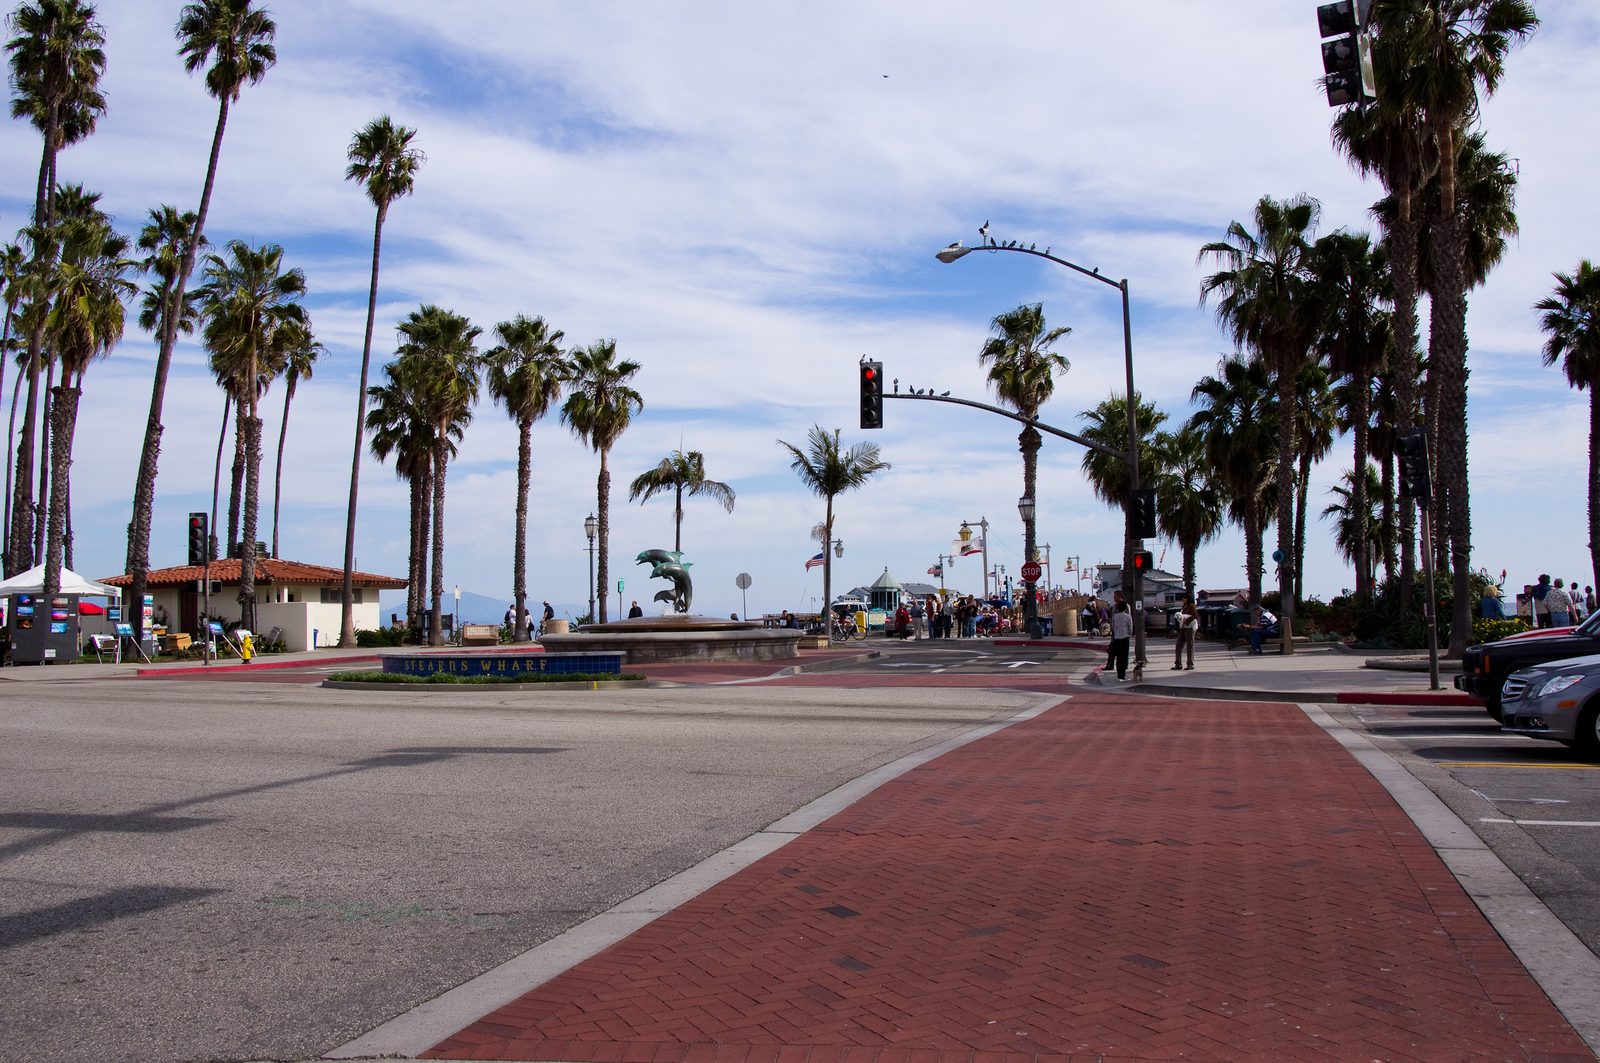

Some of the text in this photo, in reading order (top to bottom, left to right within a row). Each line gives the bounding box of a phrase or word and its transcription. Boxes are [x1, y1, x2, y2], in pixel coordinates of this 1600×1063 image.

[1022, 567, 1041, 576] STOP
[404, 659, 547, 671] STEARNS WHARF
